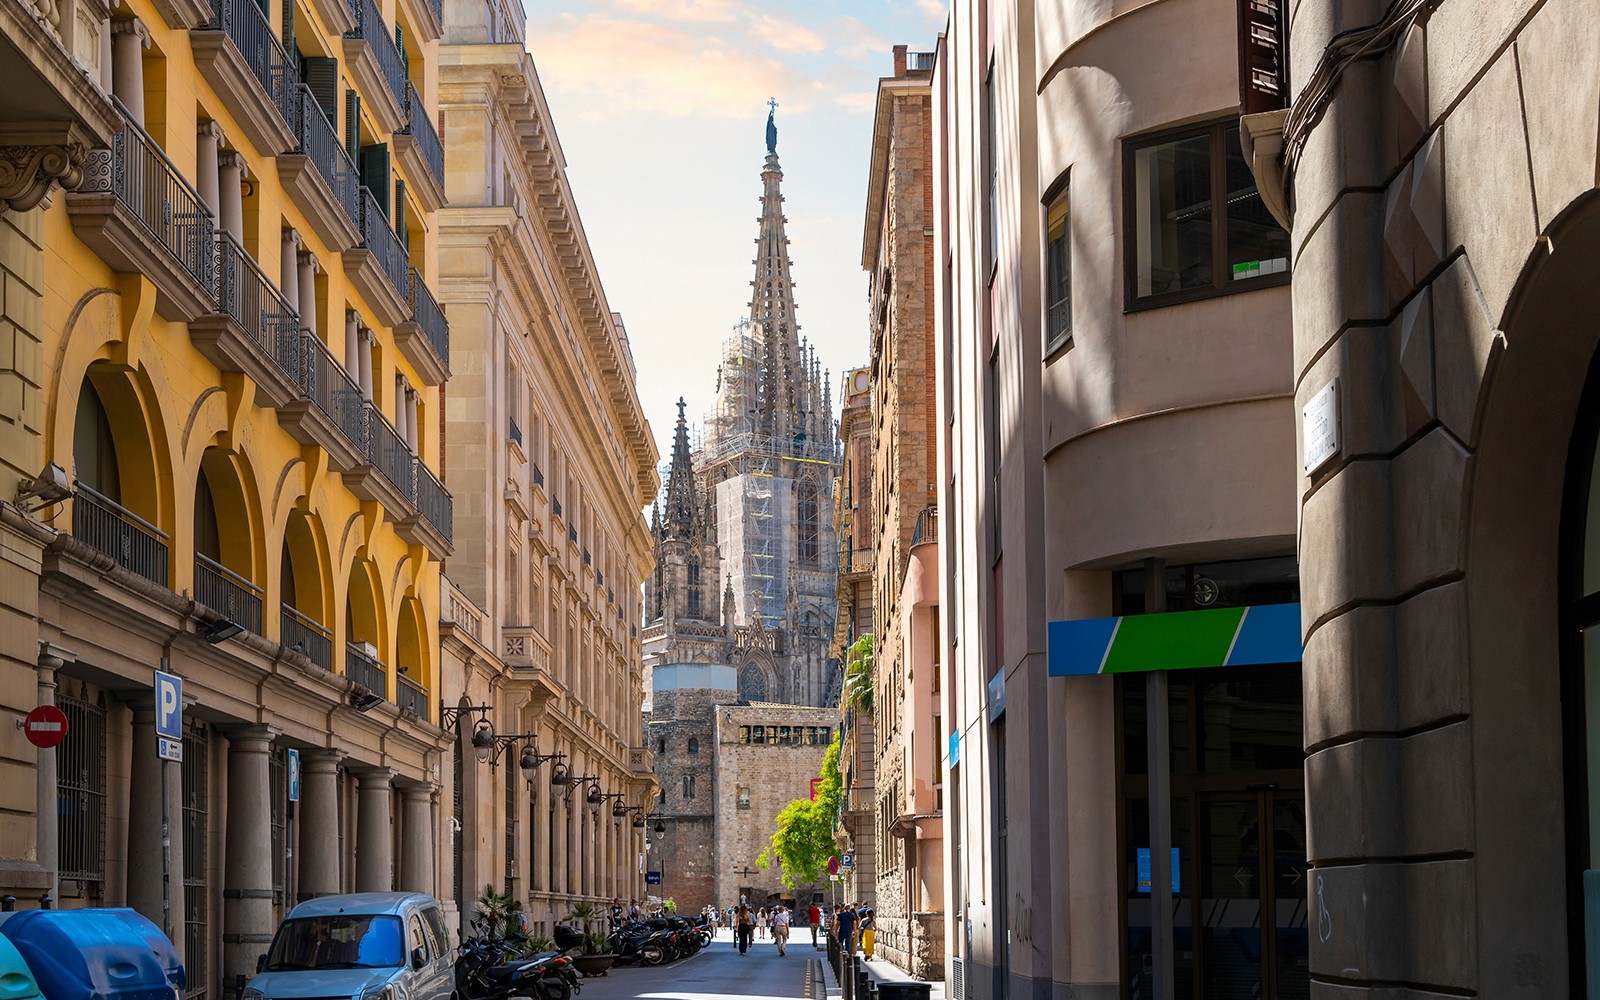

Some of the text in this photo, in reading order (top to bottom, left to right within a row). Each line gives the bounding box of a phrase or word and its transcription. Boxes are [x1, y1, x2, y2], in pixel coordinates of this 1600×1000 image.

[161, 680, 177, 728] P
[291, 755, 297, 795] P
[843, 855, 851, 865] P
